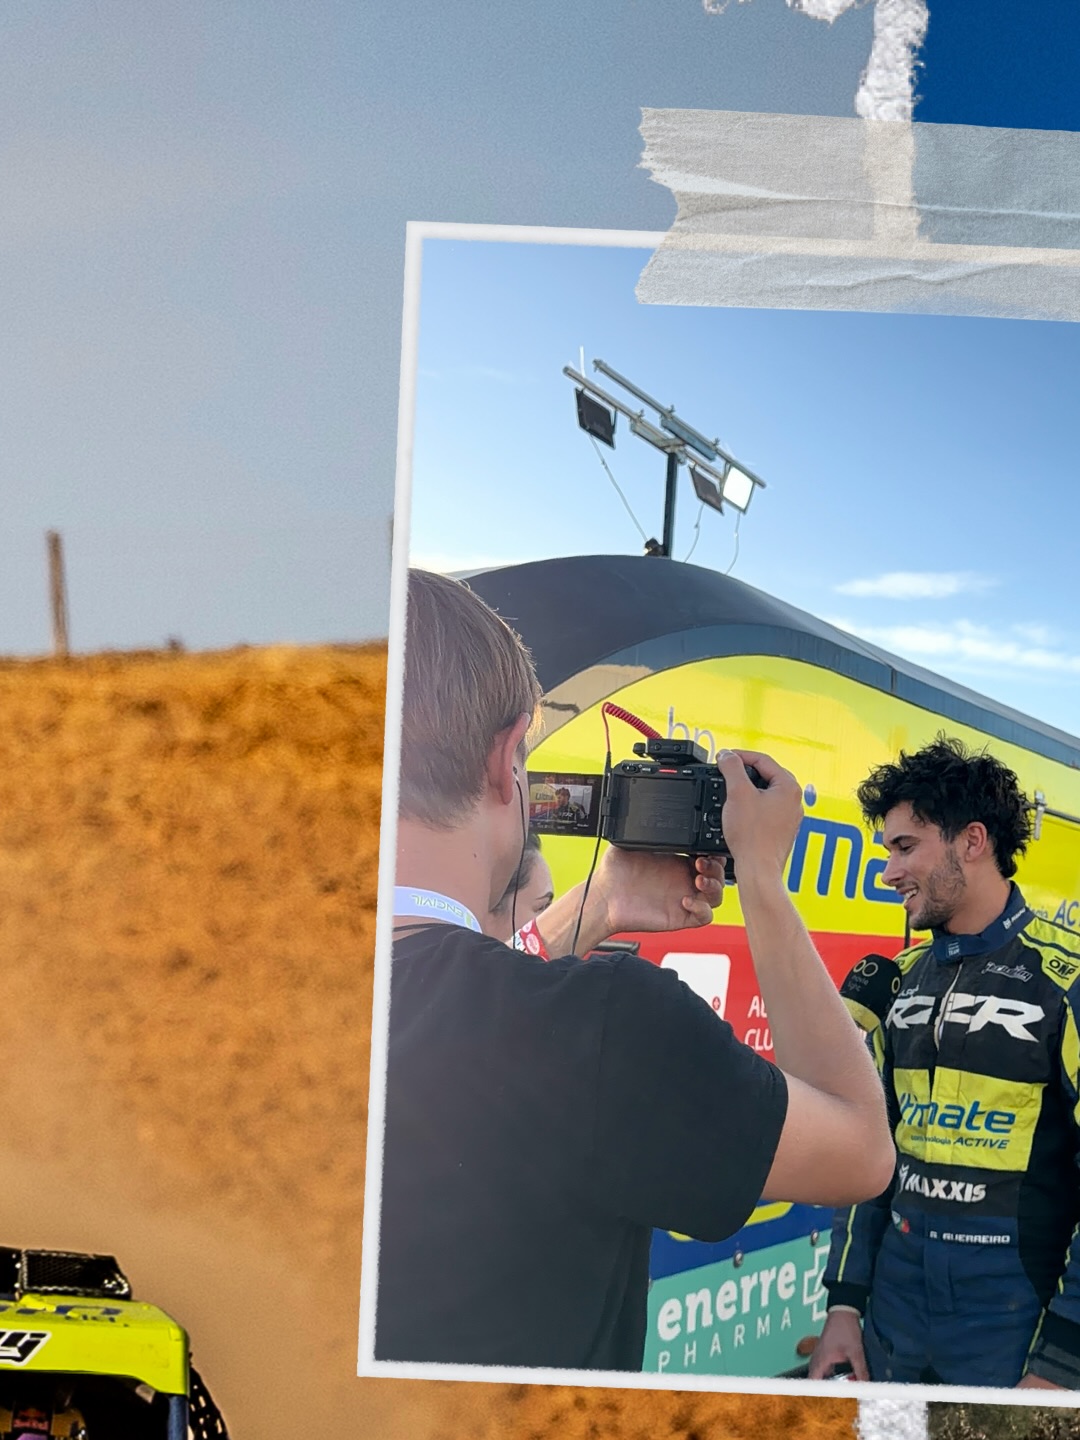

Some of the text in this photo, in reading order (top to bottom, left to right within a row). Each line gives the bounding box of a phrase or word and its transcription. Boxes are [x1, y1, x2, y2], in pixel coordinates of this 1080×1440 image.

[953, 1136, 1011, 1150] ACTIVE
[905, 1173, 987, 1203] MAXXIS
[657, 1261, 797, 1342] enerre
[658, 1306, 793, 1374] PHARMA
